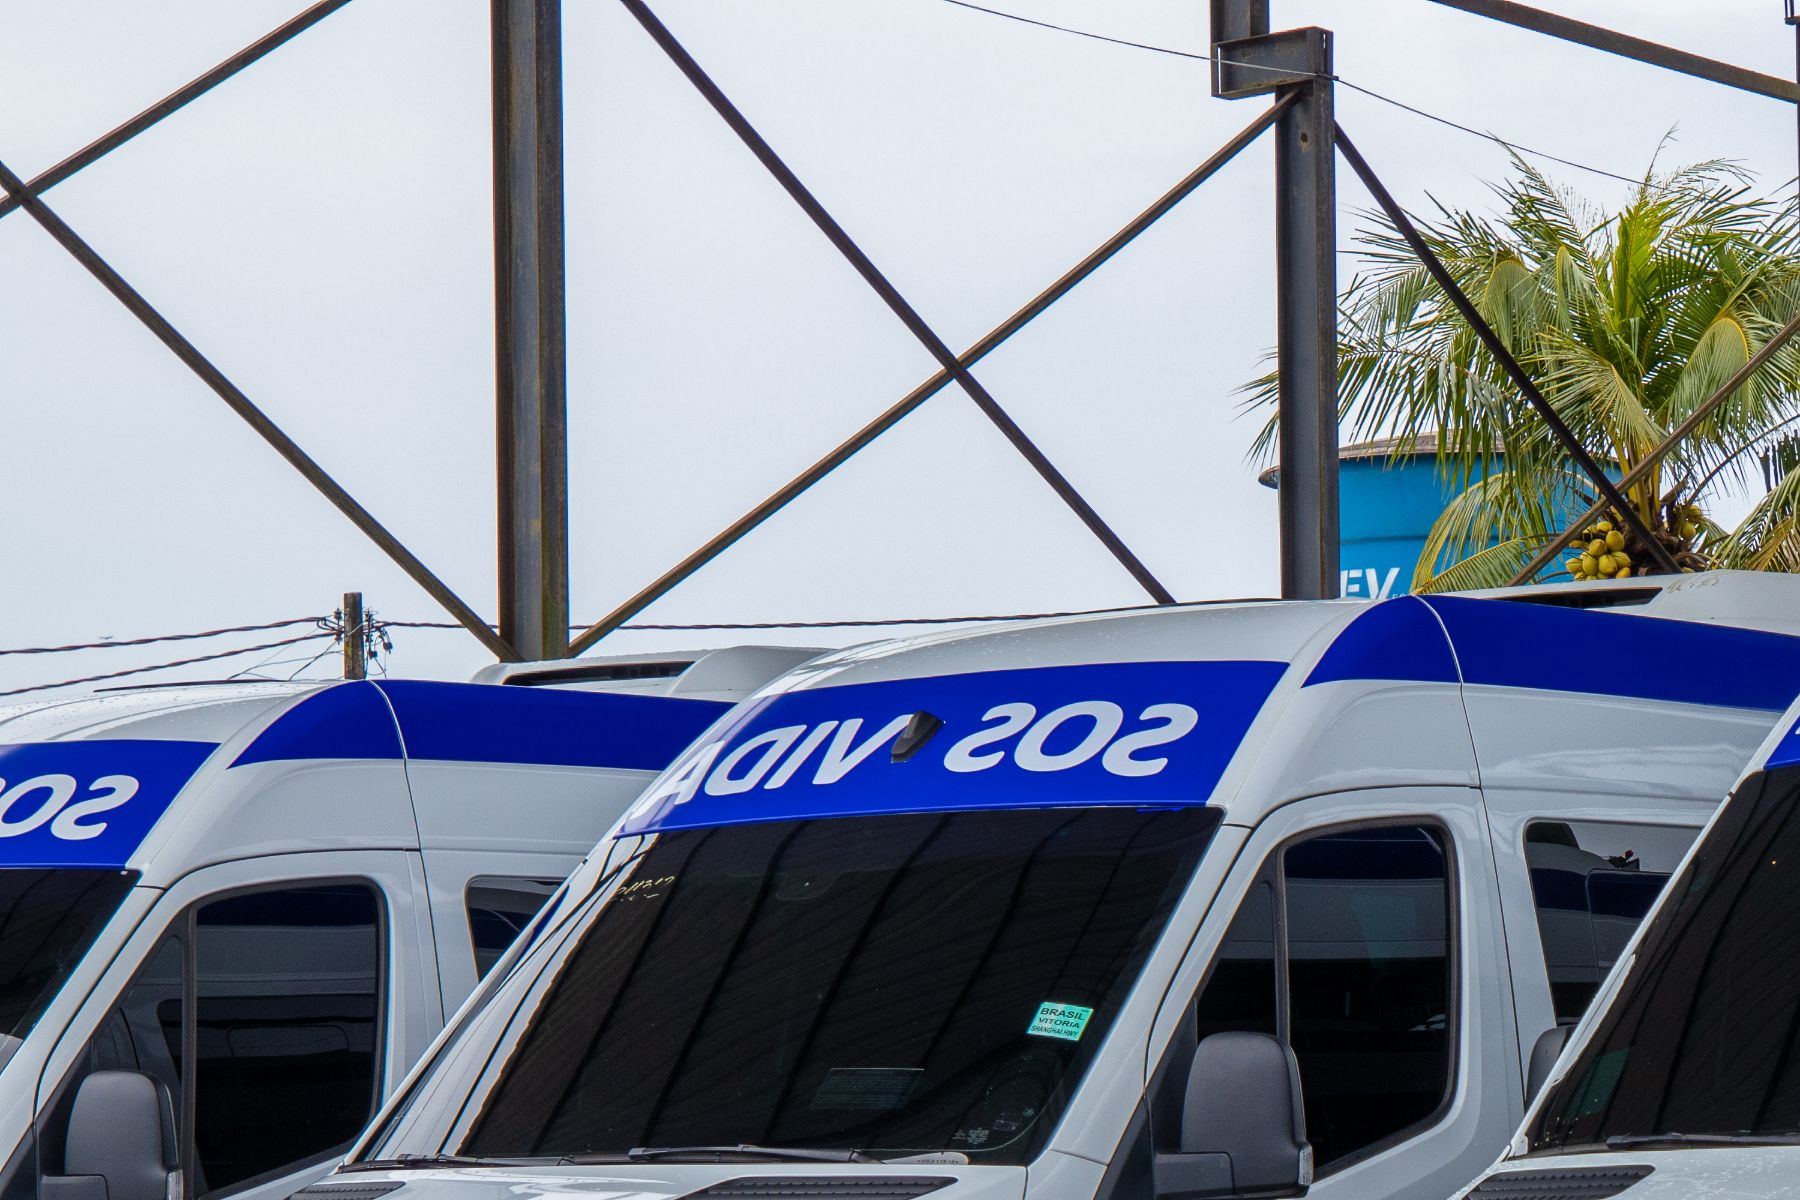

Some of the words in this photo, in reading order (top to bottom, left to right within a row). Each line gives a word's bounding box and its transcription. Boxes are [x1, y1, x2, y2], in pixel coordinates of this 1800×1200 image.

[1041, 1007, 1085, 1021] BRASIL
[1039, 1018, 1080, 1029] VITORIA
[1031, 1025, 1062, 1035] SHANGHAI
[1063, 1028, 1079, 1037] HWY
